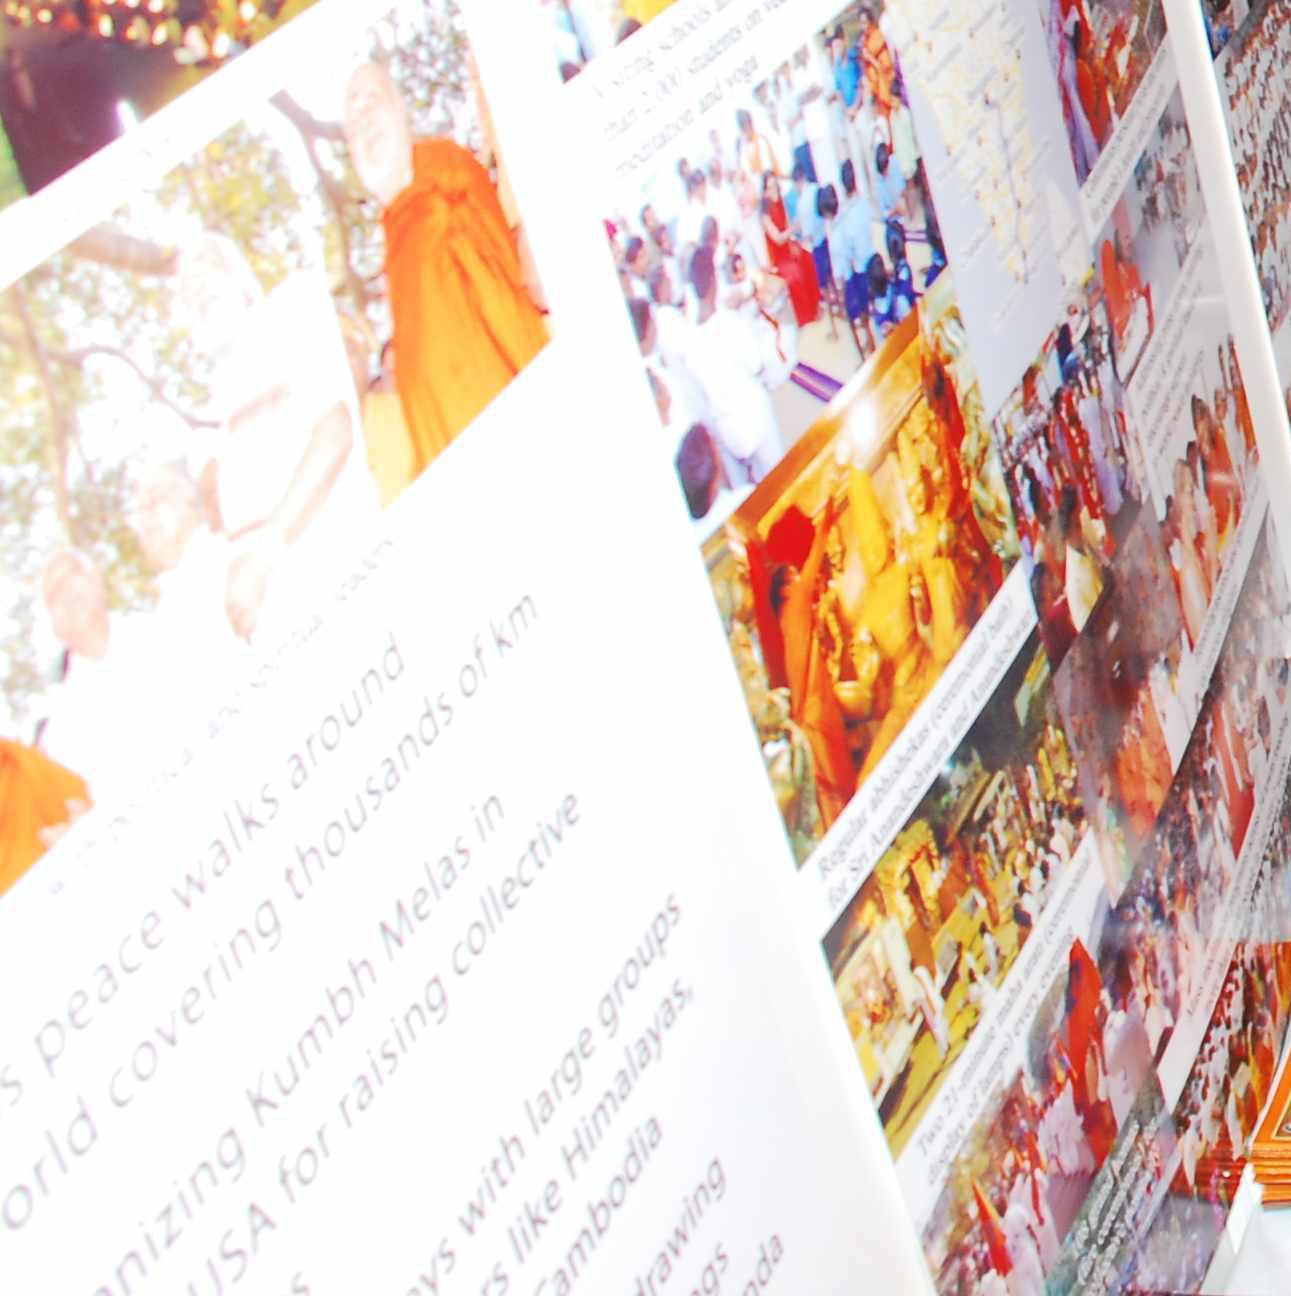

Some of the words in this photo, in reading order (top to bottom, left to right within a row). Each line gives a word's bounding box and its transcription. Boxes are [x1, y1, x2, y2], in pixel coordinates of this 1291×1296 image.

[34, 912, 163, 1078] peace
[172, 784, 279, 909] walks
[288, 641, 404, 790] around
[110, 899, 282, 1108] covering
[285, 692, 453, 900] thousands
[459, 633, 495, 698] of
[490, 595, 536, 654] km
[246, 958, 376, 1127] Kumbh
[379, 836, 470, 960] Melas
[475, 795, 504, 842] in
[279, 1124, 328, 1203] for
[340, 974, 448, 1128] raising
[452, 794, 580, 976] collective
[458, 1135, 525, 1236] with
[524, 1027, 595, 1136] large
[599, 894, 680, 1027] groups
[508, 1179, 562, 1264] like
